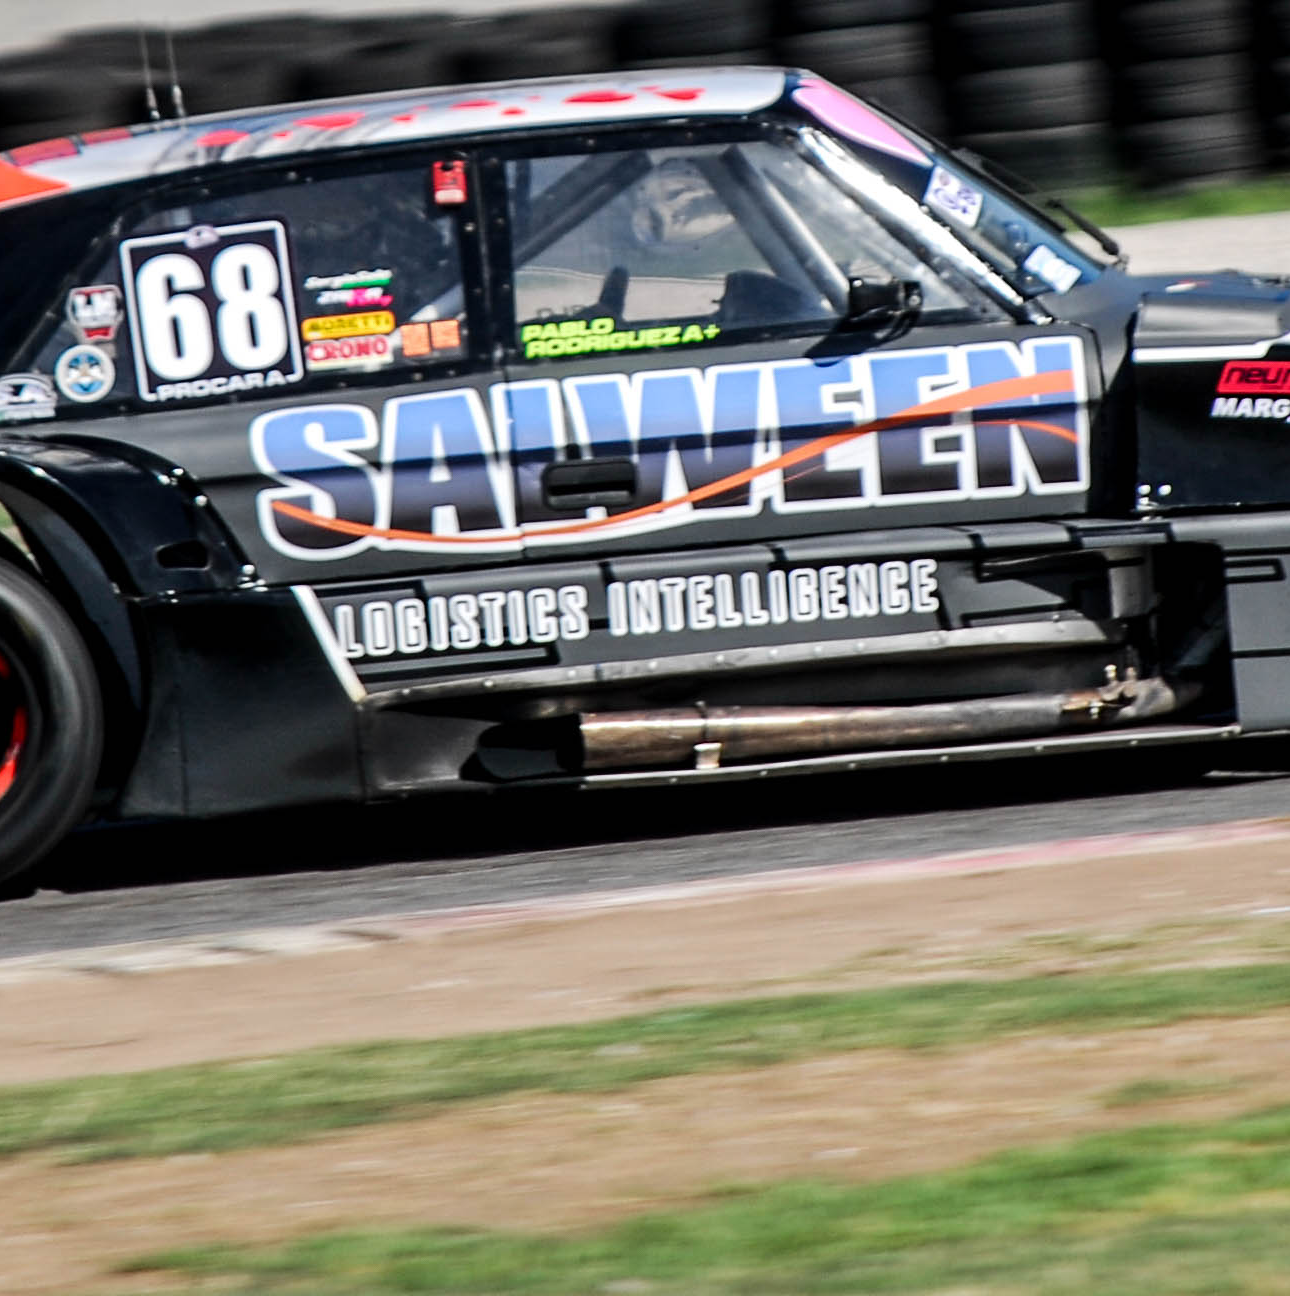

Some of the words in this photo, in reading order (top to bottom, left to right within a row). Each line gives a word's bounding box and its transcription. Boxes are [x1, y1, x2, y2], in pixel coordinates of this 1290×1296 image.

[136, 243, 288, 381] 68
[521, 317, 614, 342] PABLO
[525, 326, 682, 359] RODRIGUEZ
[156, 369, 286, 401] PROCARA
[251, 334, 1091, 563] SALWEEN
[335, 585, 590, 659] LOGISTICS
[608, 558, 940, 638] INTELLIGENCE
